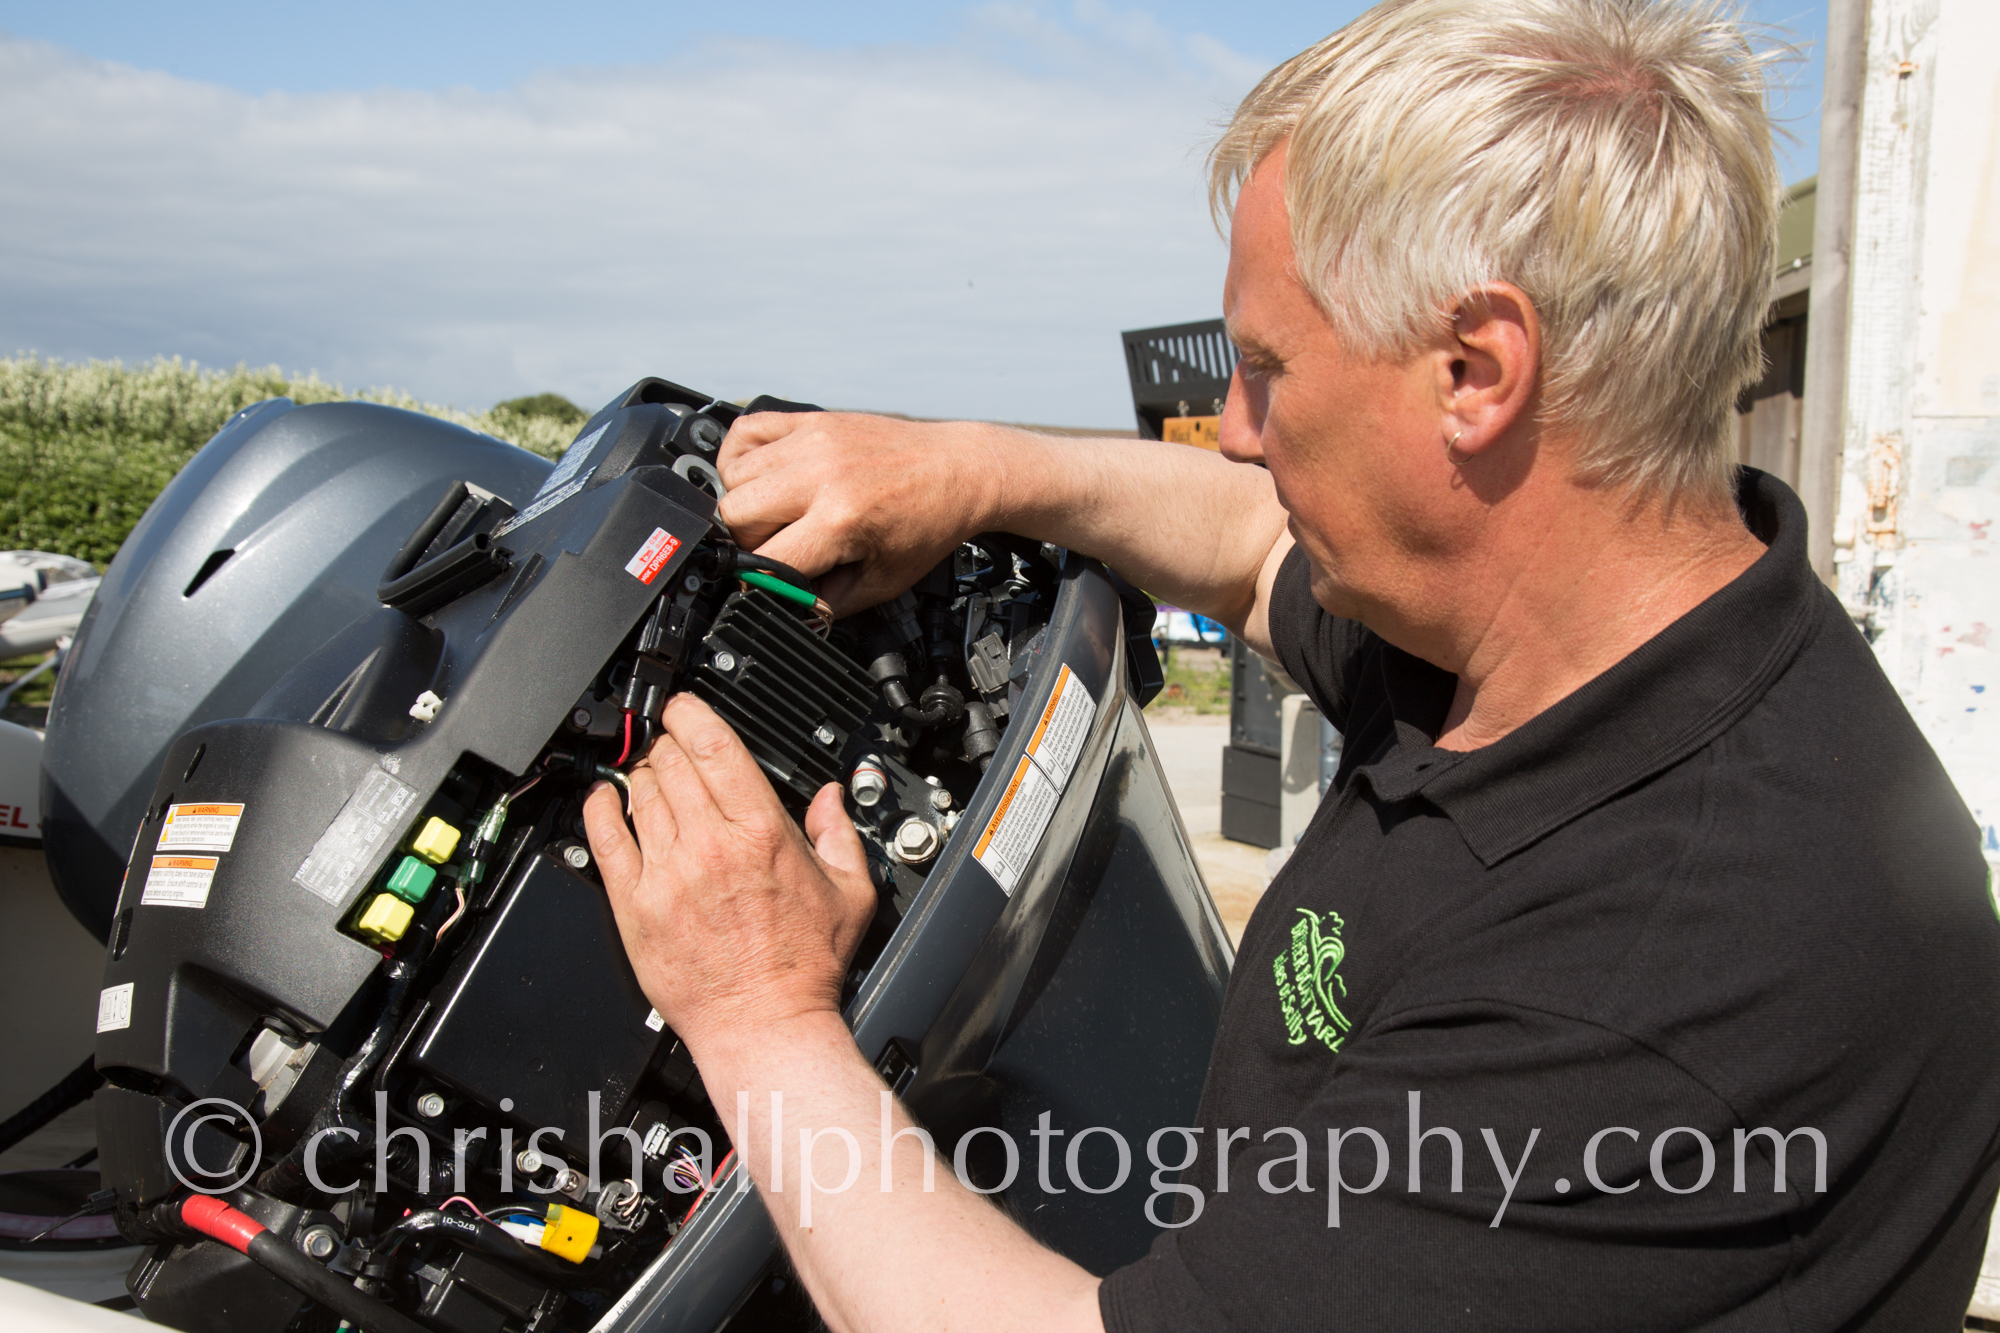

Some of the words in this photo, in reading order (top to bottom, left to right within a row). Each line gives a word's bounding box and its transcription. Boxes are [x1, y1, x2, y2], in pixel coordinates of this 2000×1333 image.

[641, 569, 652, 581] NGK
[649, 537, 678, 571] DPR6EB-9
[1045, 692, 1058, 720] WARNING
[364, 792, 380, 811] STARTER
[378, 778, 390, 793] RELAY
[991, 778, 1019, 829] AVERTISSEMENT
[382, 806, 398, 825] Yellow
[355, 844, 370, 862] Green
[295, 858, 312, 878] FUSE
[329, 880, 344, 899] Yellow
[441, 1217, 478, 1233] 67C-01
